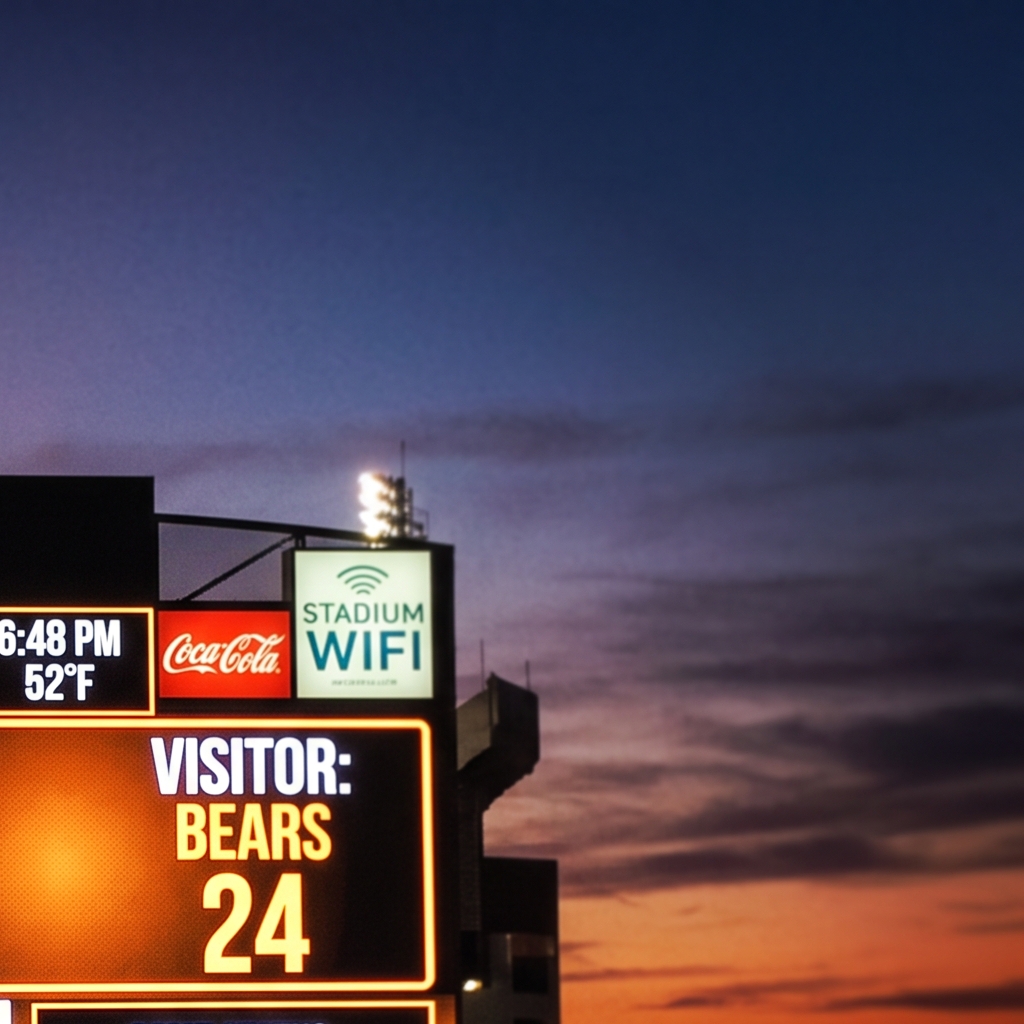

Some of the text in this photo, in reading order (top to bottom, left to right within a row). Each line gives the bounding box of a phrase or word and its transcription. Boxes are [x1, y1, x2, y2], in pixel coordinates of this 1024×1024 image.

[74, 619, 121, 657] PM
[303, 602, 424, 624] STADIUM
[306, 630, 422, 671] WIFI
[151, 736, 353, 796] VISITOR:
[176, 803, 333, 862] BEARS
[202, 872, 311, 974] 24
